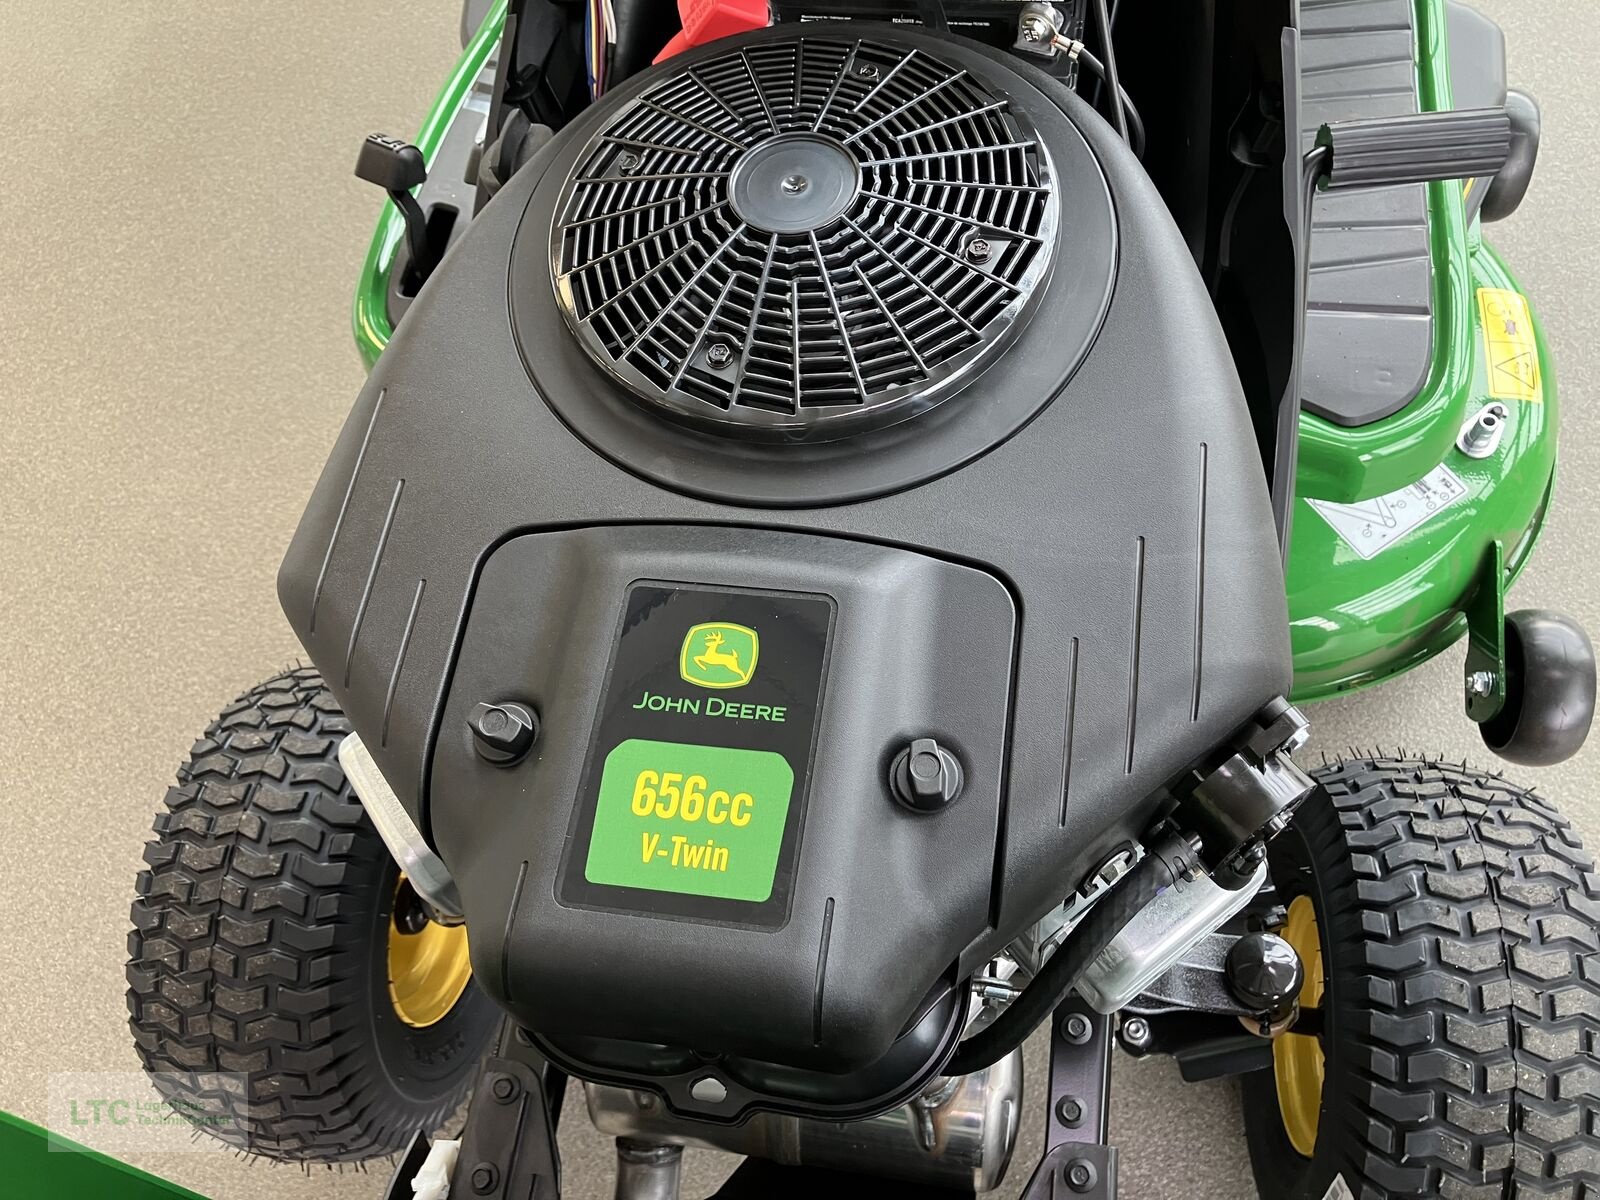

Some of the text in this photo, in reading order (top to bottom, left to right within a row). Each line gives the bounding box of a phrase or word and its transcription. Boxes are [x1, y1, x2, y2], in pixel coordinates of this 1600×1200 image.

[632, 691, 787, 722] JOHN DEERE
[630, 769, 754, 828] 656cc
[640, 832, 730, 872] V-Twin
